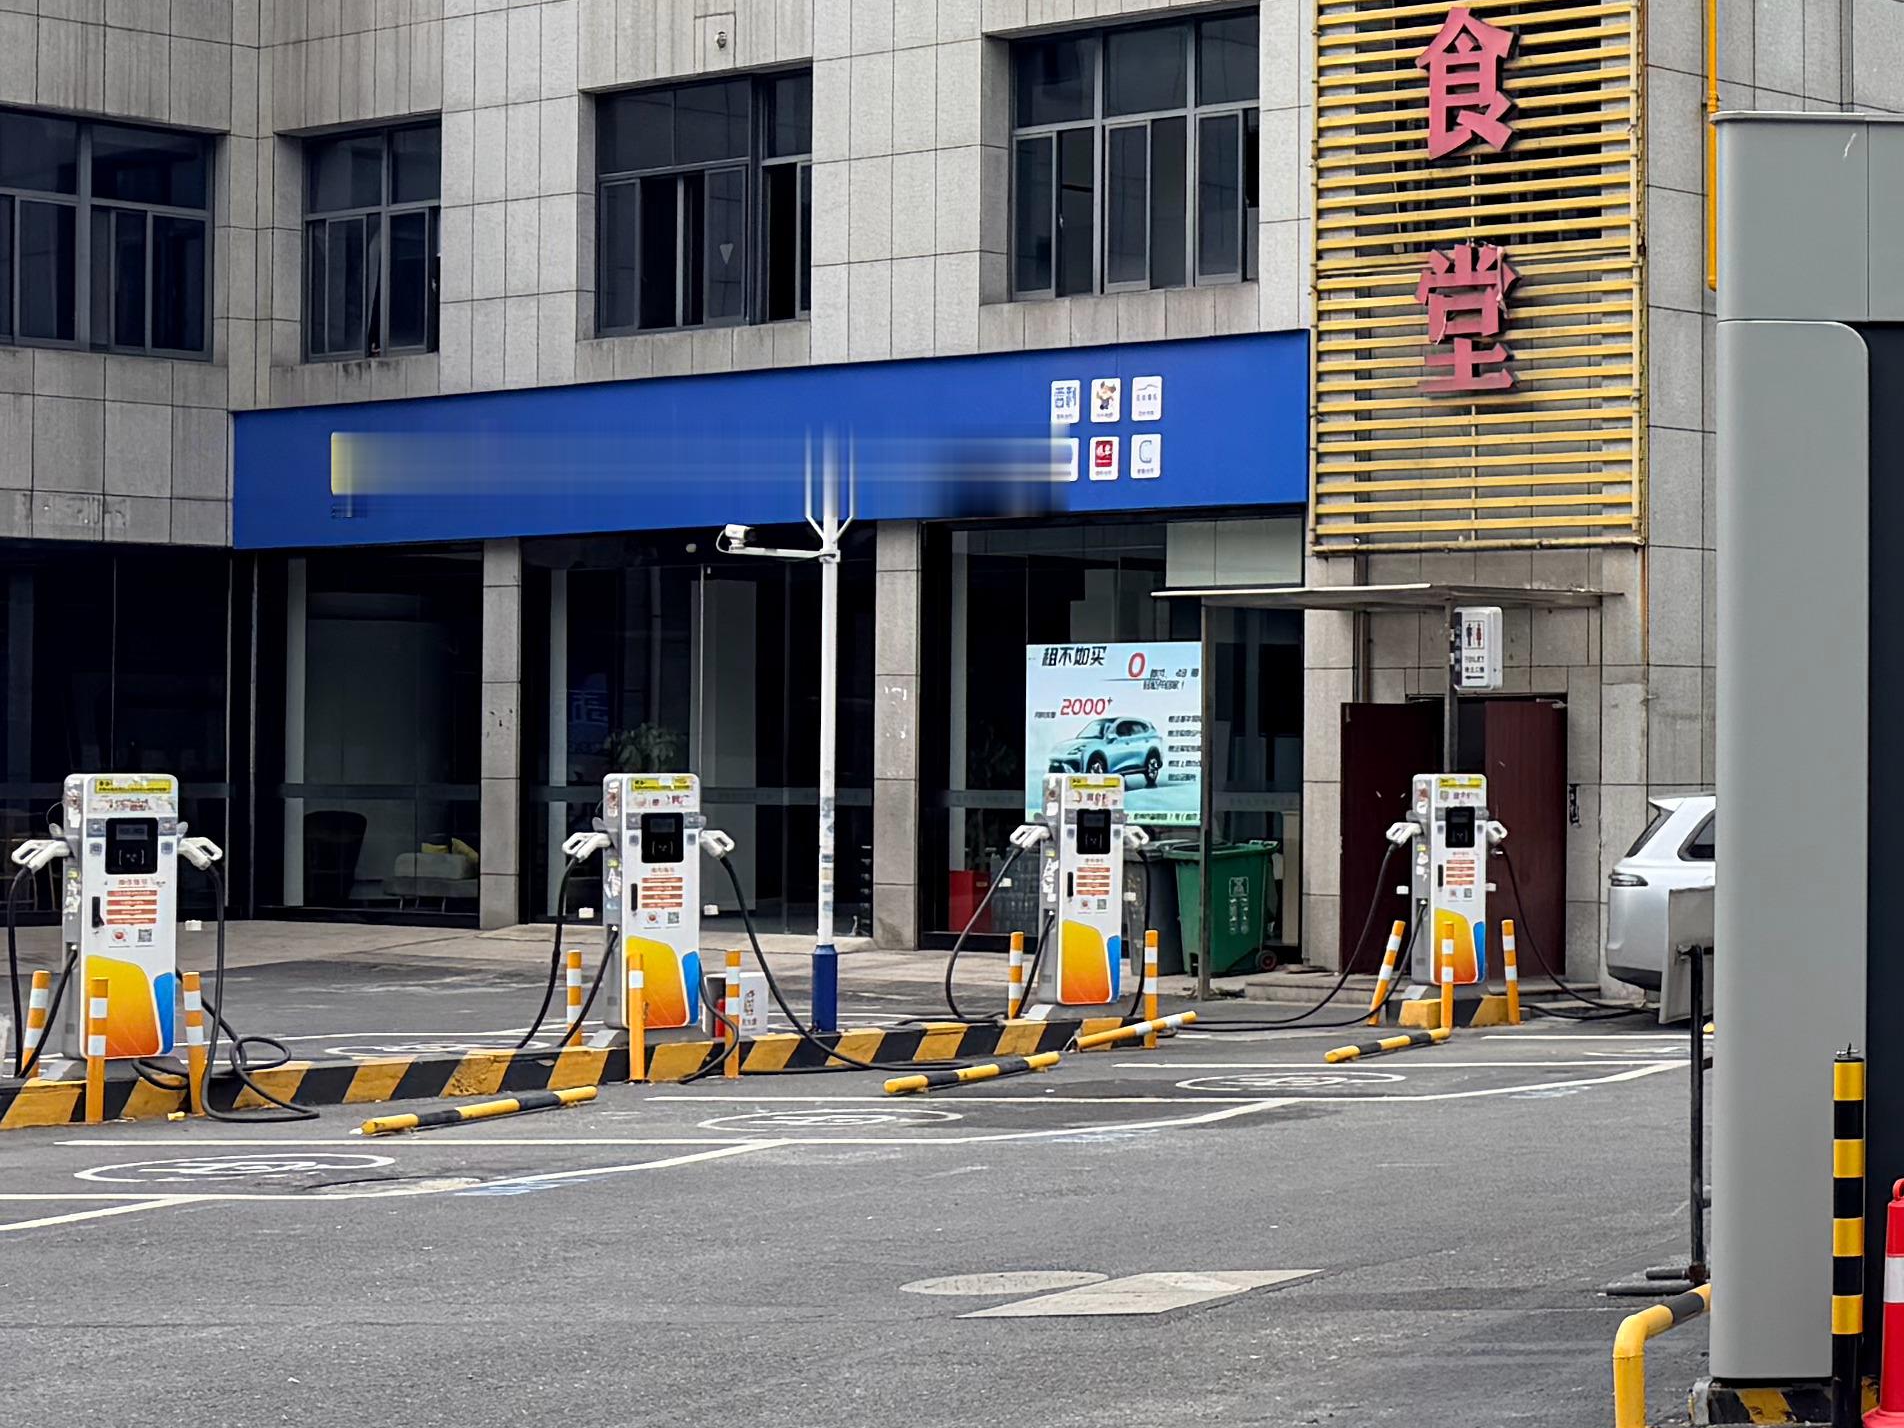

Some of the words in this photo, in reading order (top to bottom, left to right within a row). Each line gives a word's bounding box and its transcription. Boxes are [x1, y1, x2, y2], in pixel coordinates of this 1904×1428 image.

[1414, 7, 1521, 393] 食堂
[1042, 645, 1107, 667] 租不如买
[1128, 652, 1146, 679] 0
